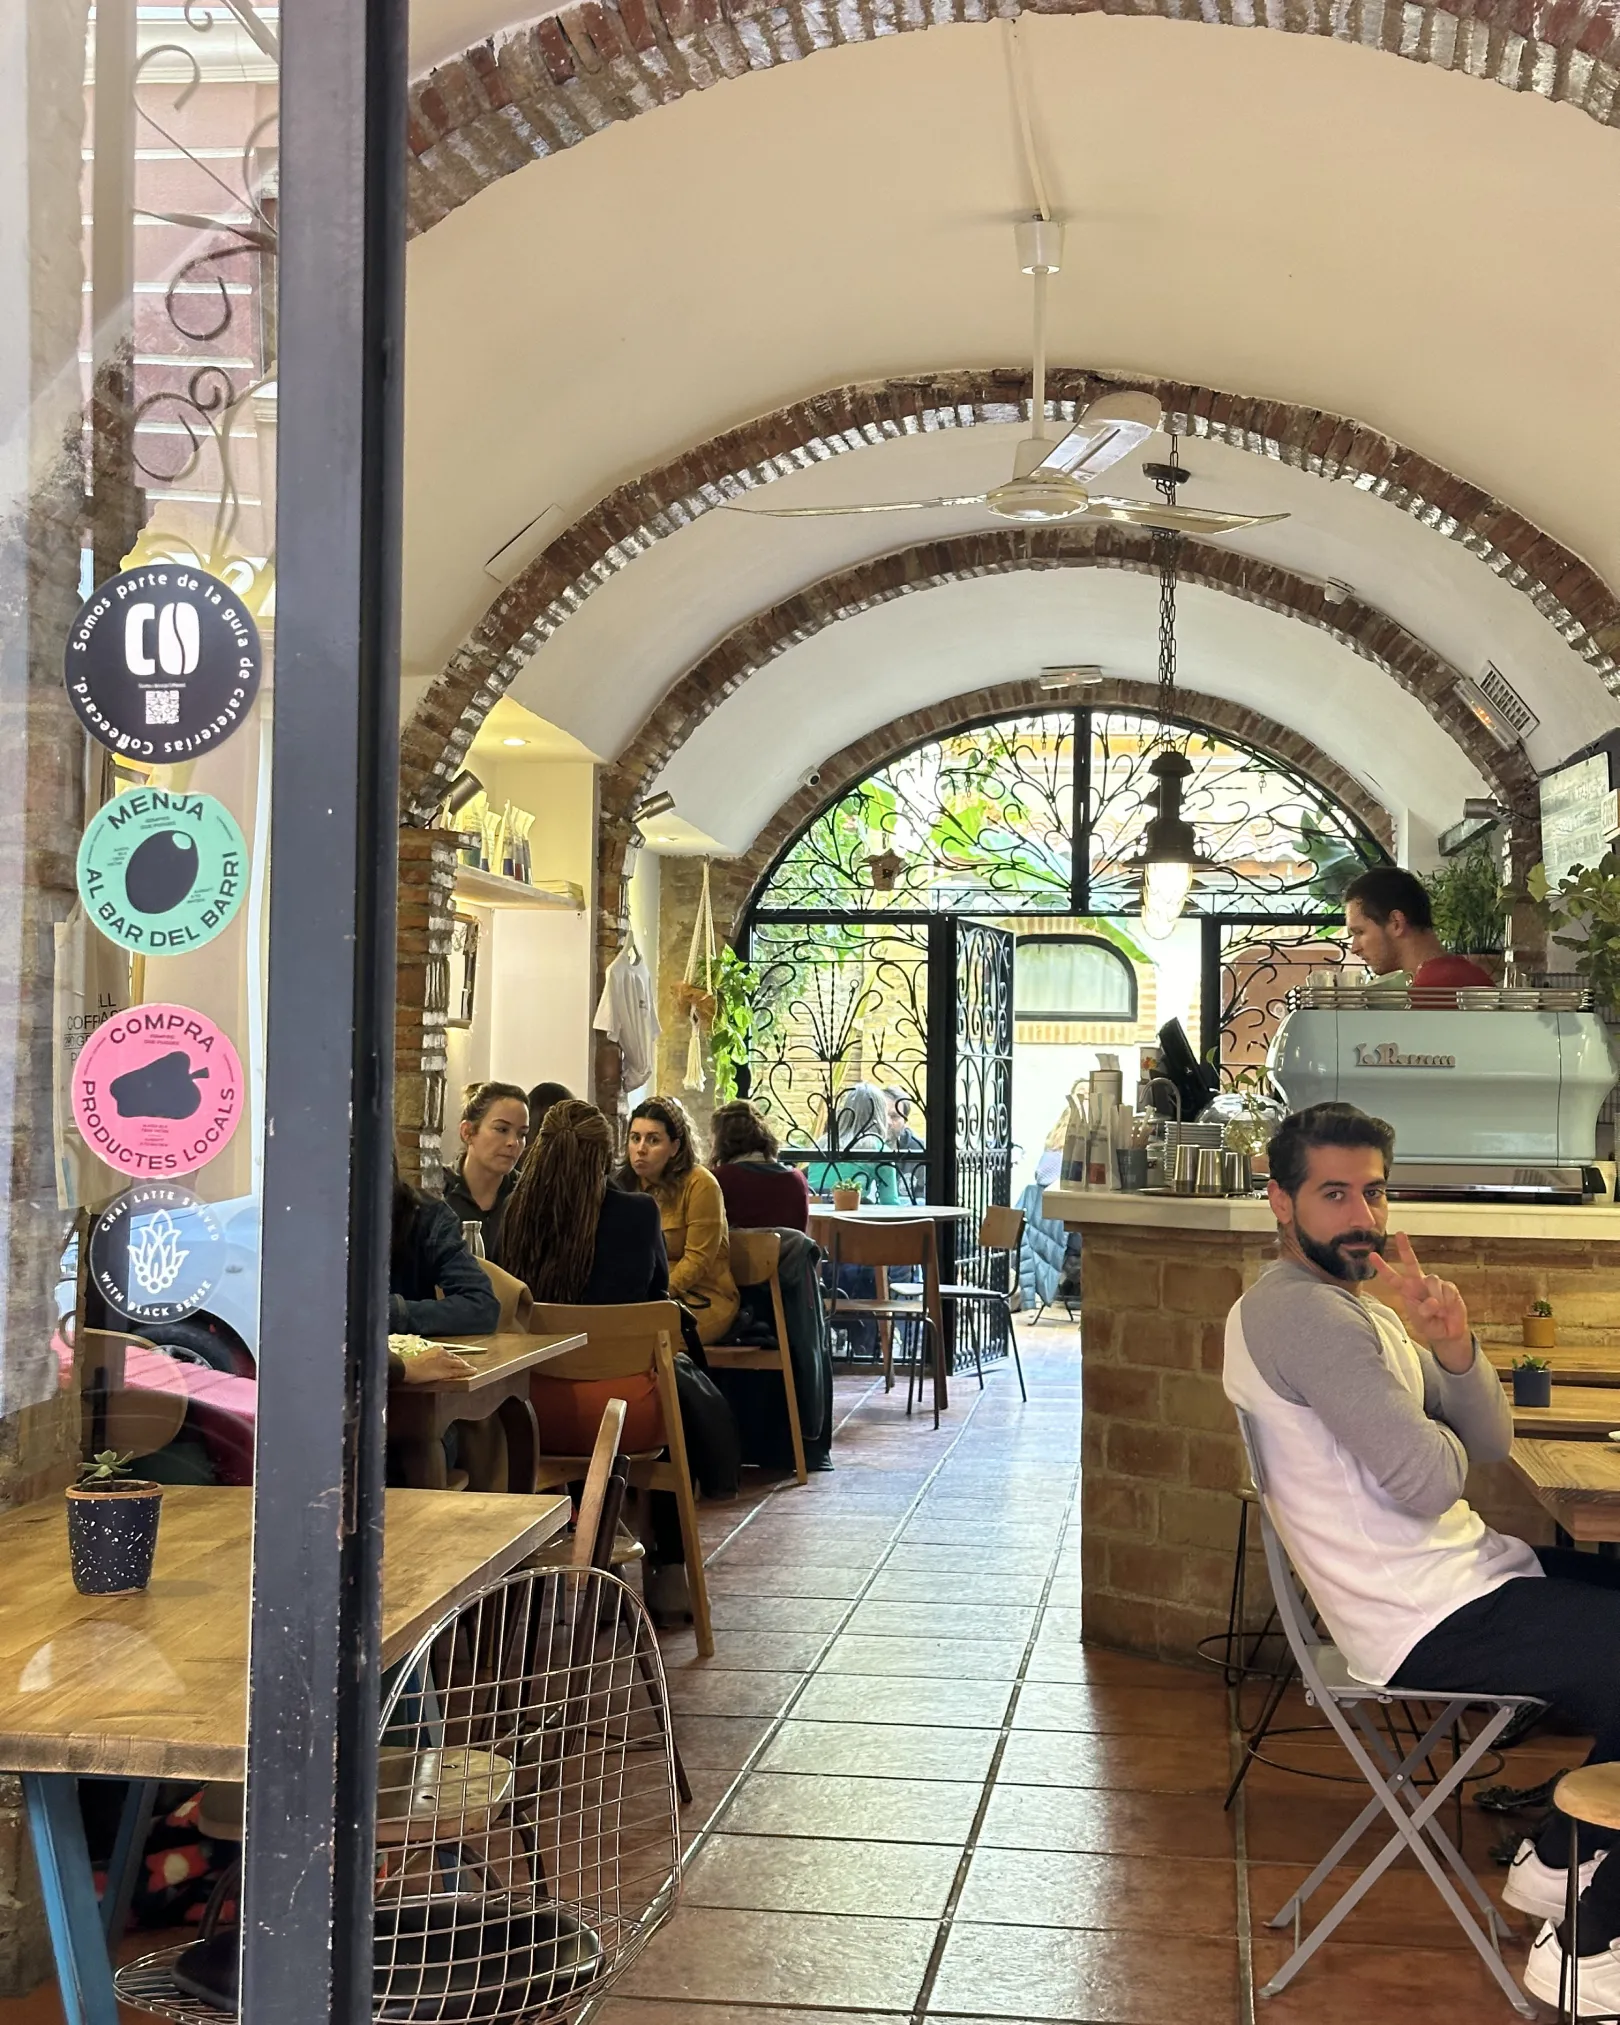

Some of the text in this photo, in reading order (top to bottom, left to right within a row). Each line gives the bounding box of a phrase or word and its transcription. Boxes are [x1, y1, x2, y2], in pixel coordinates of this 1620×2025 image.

[73, 597, 111, 651] Somos
[116, 573, 168, 599] parte
[177, 573, 199, 591] de
[204, 585, 222, 605] la
[238, 657, 254, 679] de
[107, 792, 204, 830] MENJA
[86, 867, 105, 899] AL
[98, 901, 144, 943] BAR
[150, 925, 201, 947] DEL
[200, 851, 239, 929] BARRI
[110, 1013, 215, 1053] COMPRA
[82, 1080, 235, 1170] PRODUCTES LOCALS
[101, 1201, 128, 1232] CHAI
[134, 1190, 175, 1203] LATTE
[100, 1271, 212, 1316] WITH BLACK SENSE
